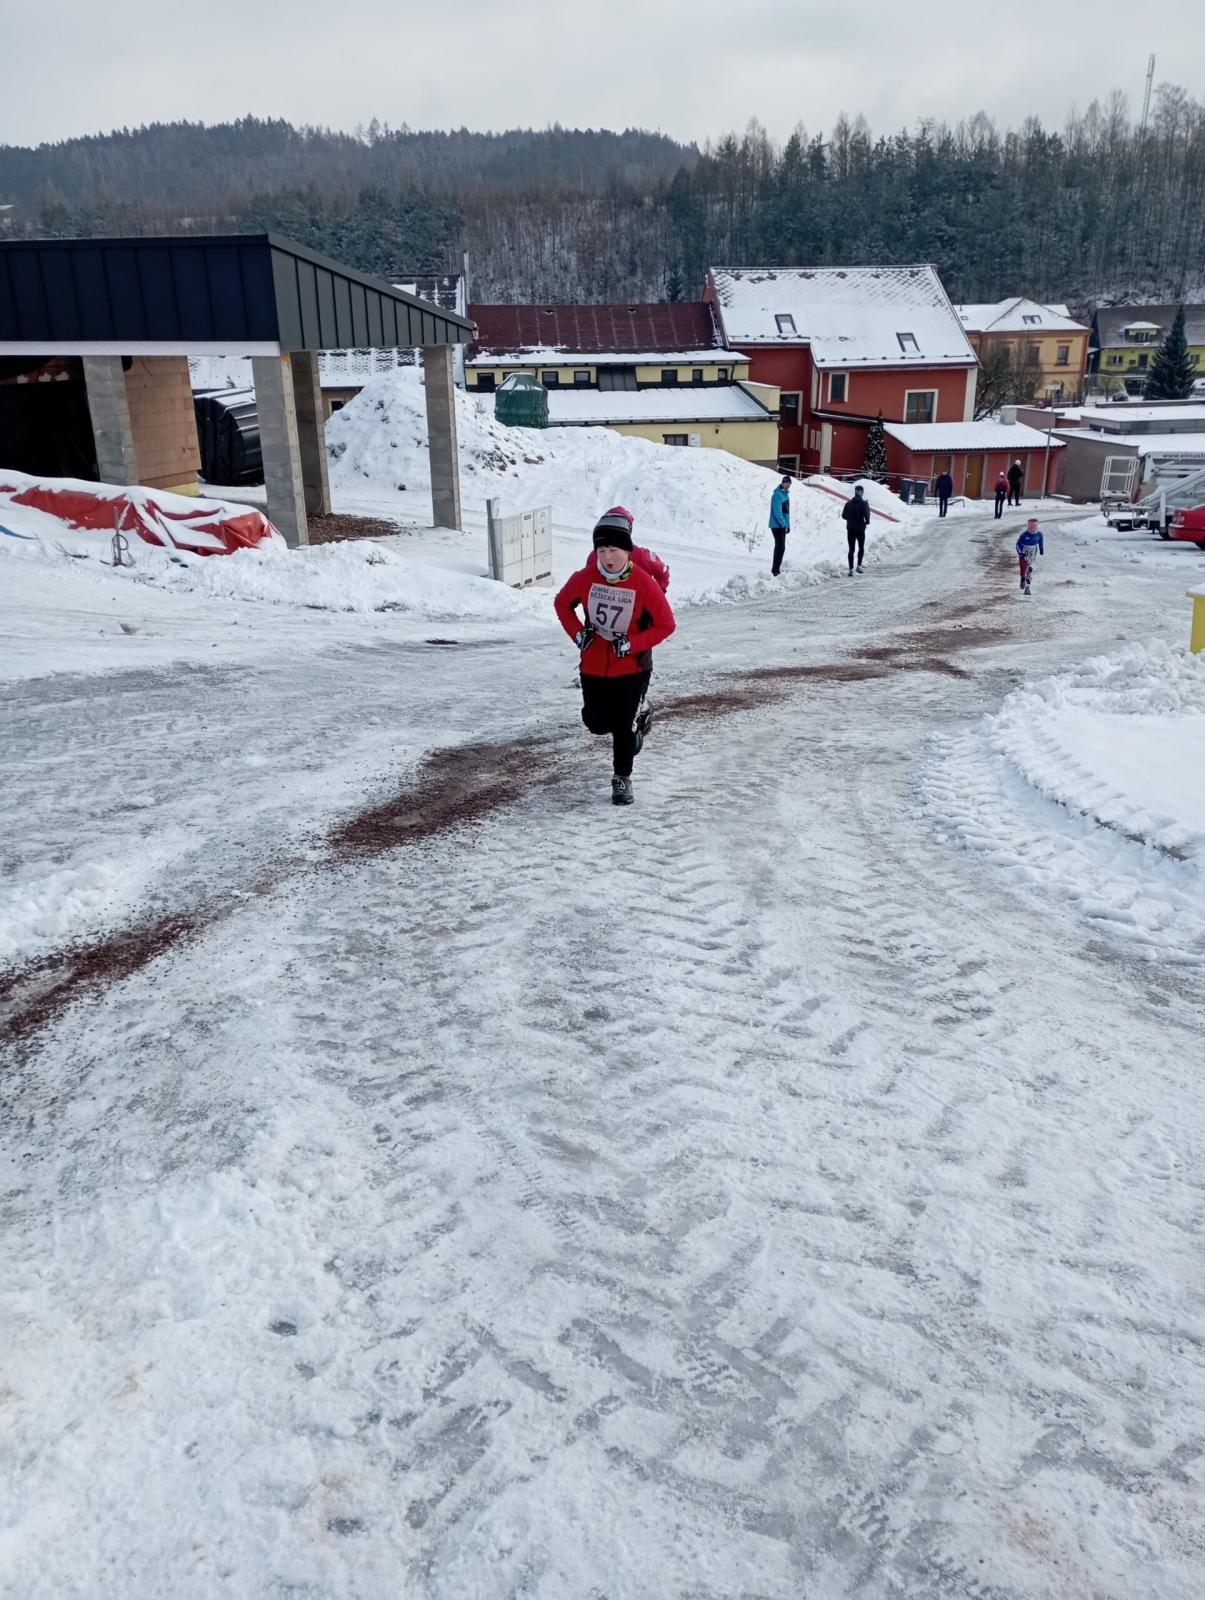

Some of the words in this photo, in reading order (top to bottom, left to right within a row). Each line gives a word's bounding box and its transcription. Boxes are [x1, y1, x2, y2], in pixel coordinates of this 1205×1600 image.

[592, 586, 609, 594] ZIMNÍ
[590, 592, 616, 601] BĚŽECKÁ
[596, 603, 624, 629] 57
